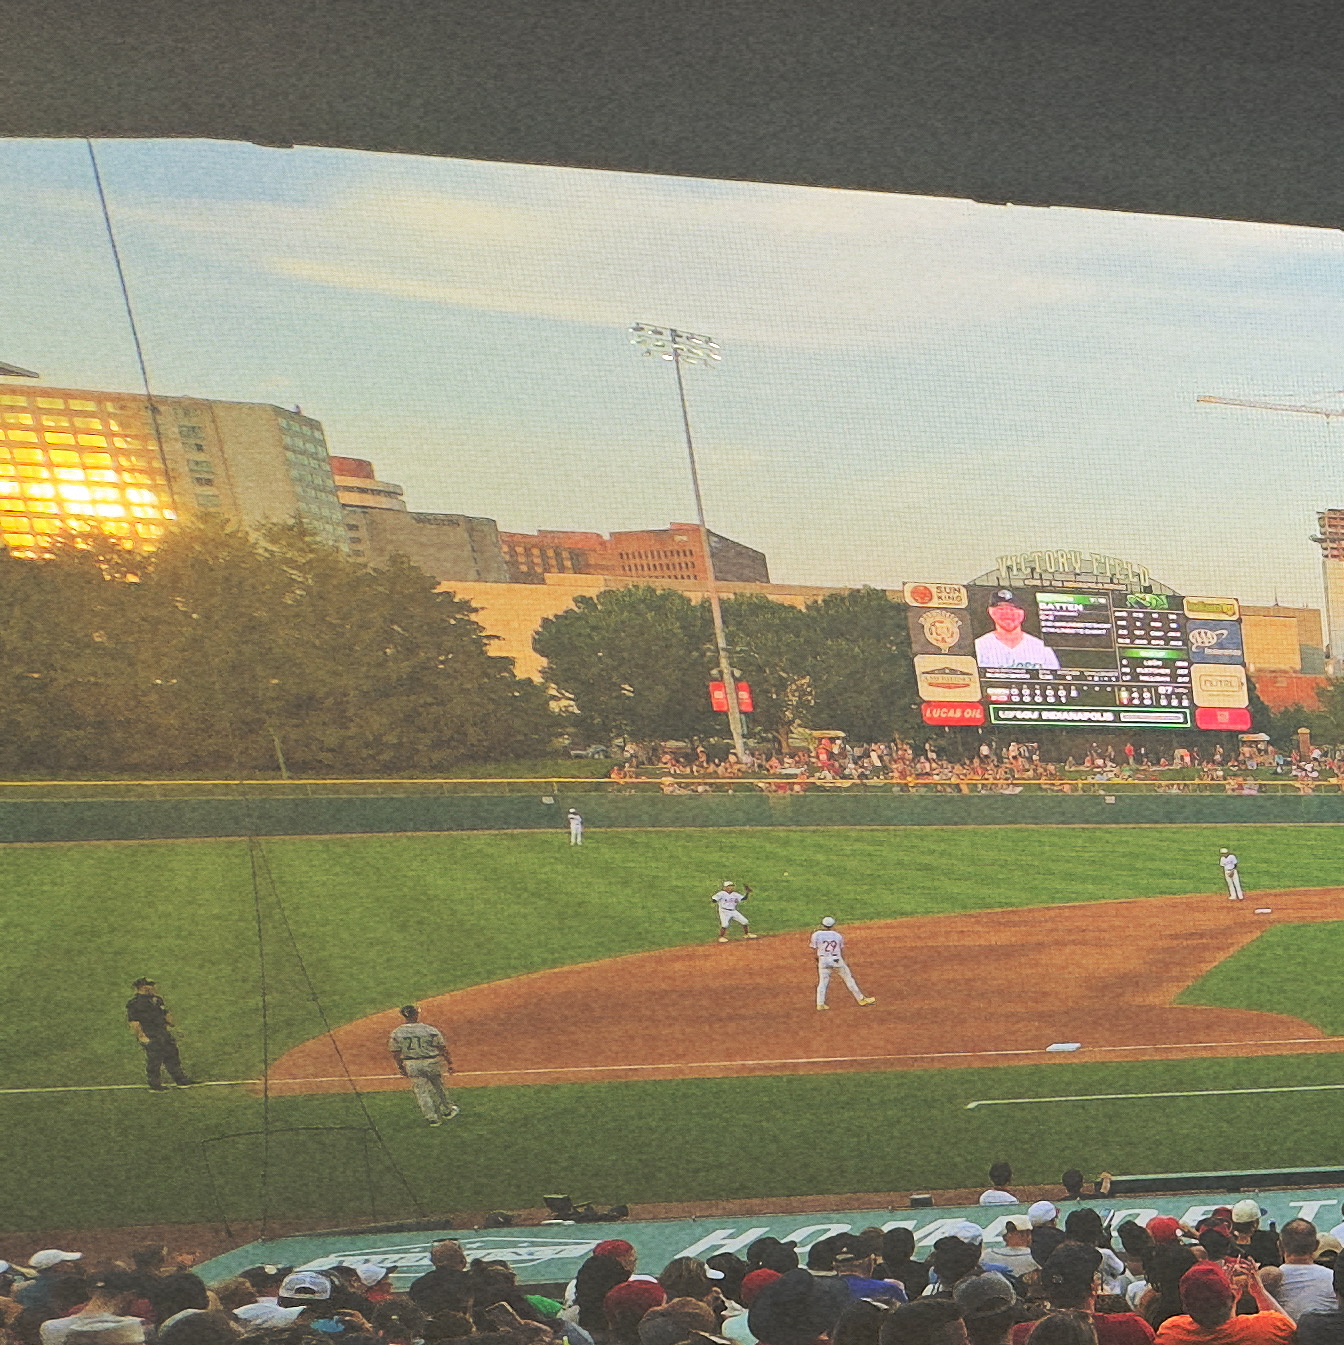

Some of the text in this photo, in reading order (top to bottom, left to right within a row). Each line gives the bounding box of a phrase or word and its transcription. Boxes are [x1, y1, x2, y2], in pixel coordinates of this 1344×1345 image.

[996, 548, 1152, 587] VICTORY FIELD
[936, 585, 961, 594] SUN
[925, 707, 983, 719] LUCAS OIL
[821, 939, 839, 953] 29
